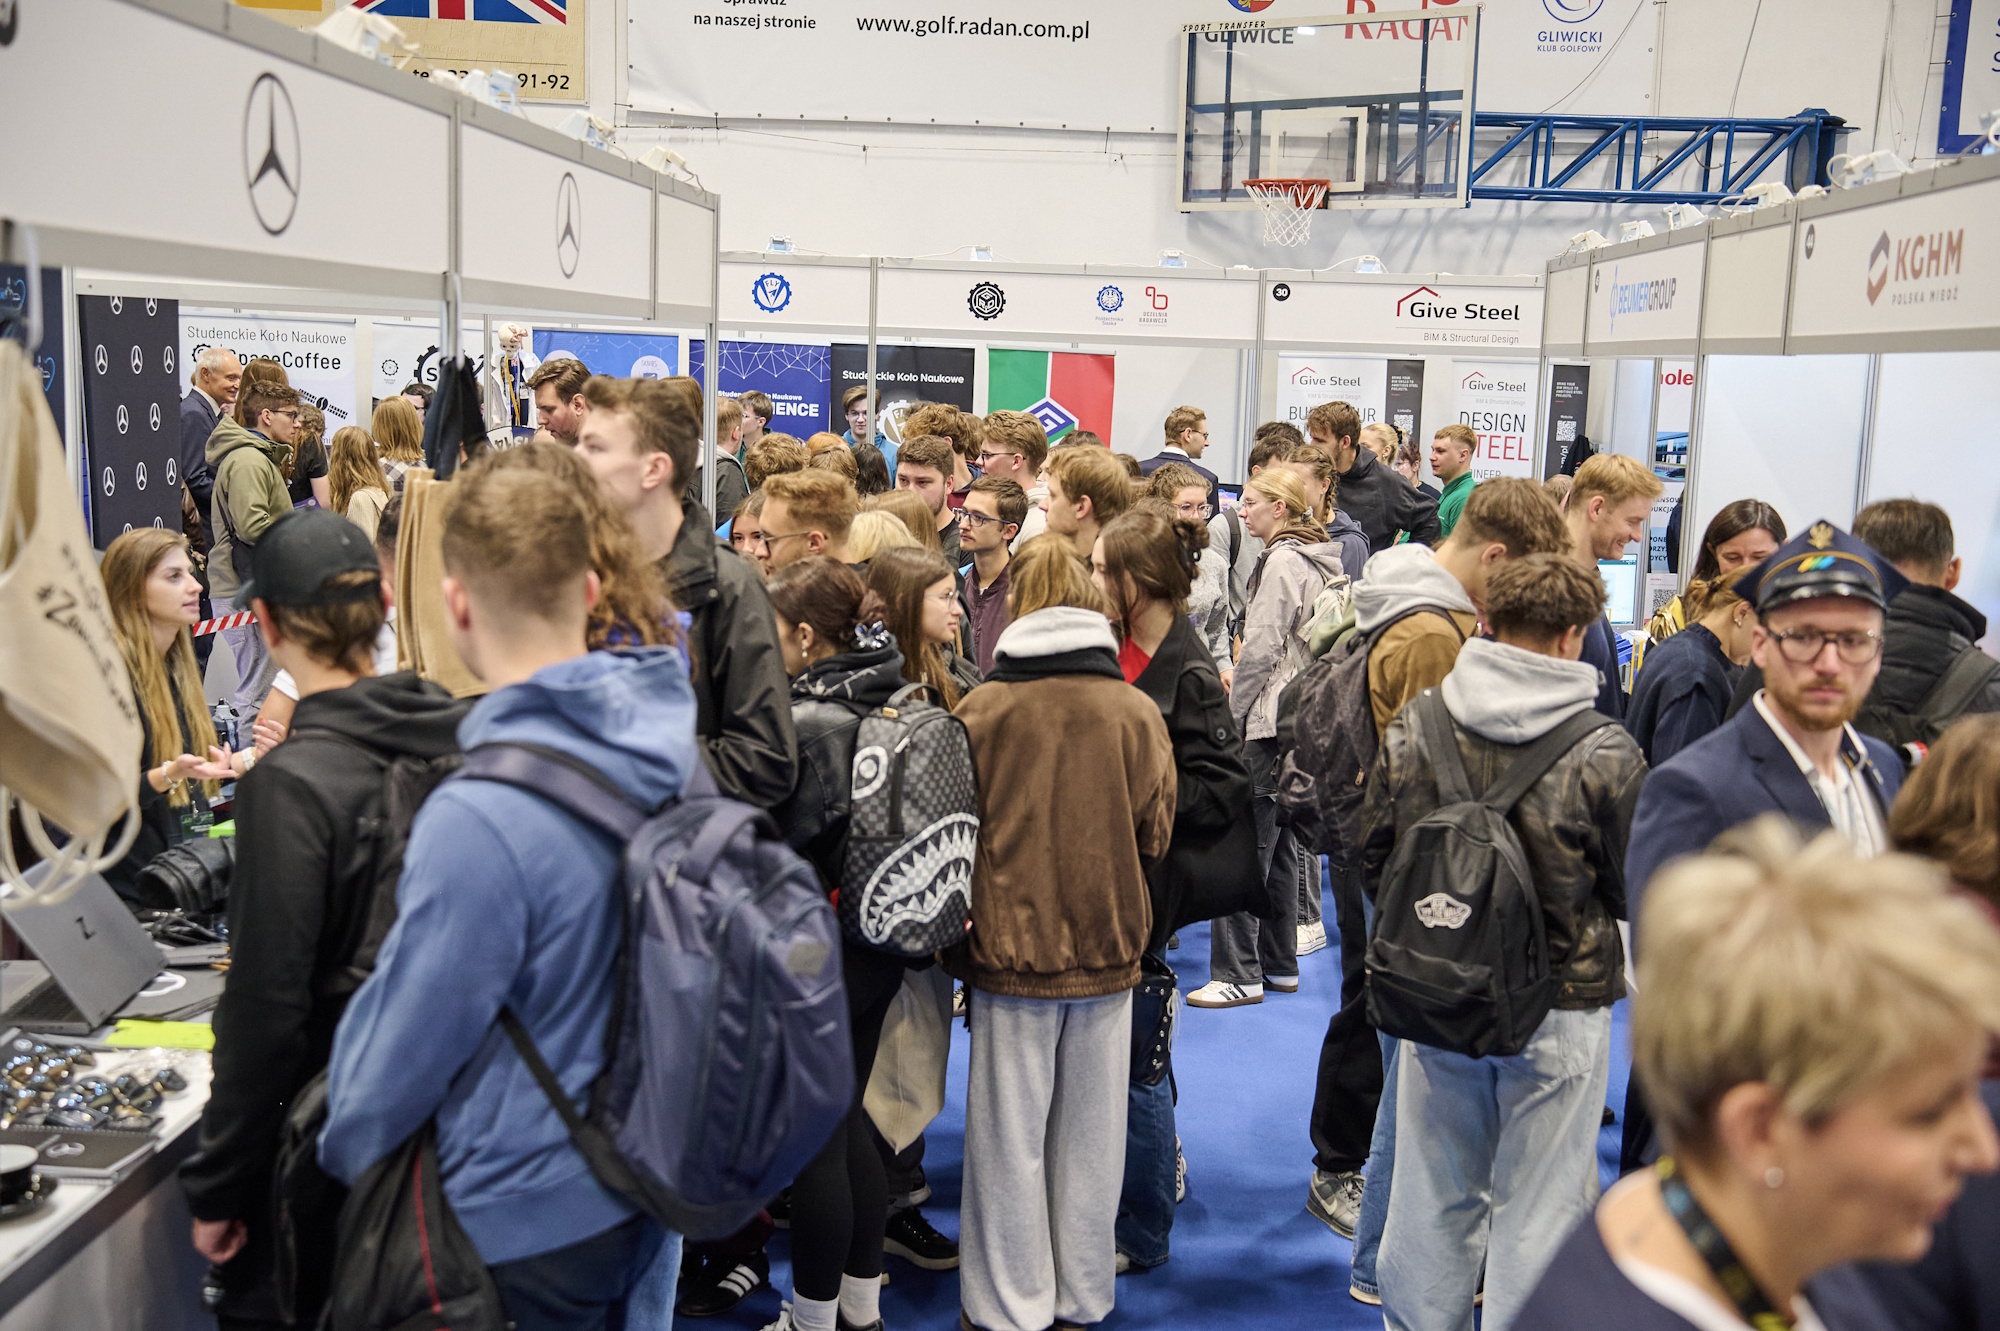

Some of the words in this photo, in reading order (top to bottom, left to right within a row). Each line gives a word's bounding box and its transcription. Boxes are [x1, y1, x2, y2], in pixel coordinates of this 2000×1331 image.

[693, 13, 711, 25] na
[715, 13, 760, 30] naszej
[764, 15, 816, 29] stronie
[856, 15, 1090, 42] www.golf.radan.com.pl
[1183, 23, 1212, 32] SPORT
[1219, 21, 1266, 31] TRANSFER
[1537, 31, 1602, 42] GLIWICKI
[1895, 228, 1964, 282] KGHM
[765, 279, 780, 287] FLY
[1276, 288, 1288, 297] 30
[1892, 290, 1924, 306] POLSKA
[1410, 301, 1457, 318] Give
[1464, 303, 1520, 321] Steel
[187, 326, 256, 341] Studenckie
[260, 329, 288, 342] Koło
[292, 331, 347, 345] Naukowe
[1424, 332, 1439, 341] BIM
[1442, 333, 1447, 341] &
[1450, 333, 1489, 343] Structural
[1492, 334, 1519, 345] Design
[842, 370, 896, 381] Studeckie
[921, 373, 964, 384] Naukowe
[1299, 375, 1326, 386] Give
[1330, 376, 1361, 387] Steel
[1469, 380, 1494, 391] Give
[1497, 381, 1526, 392] Steel
[1459, 411, 1526, 433] DESIGN
[1476, 434, 1530, 461] TEEL
[1470, 469, 1502, 479] INEER
